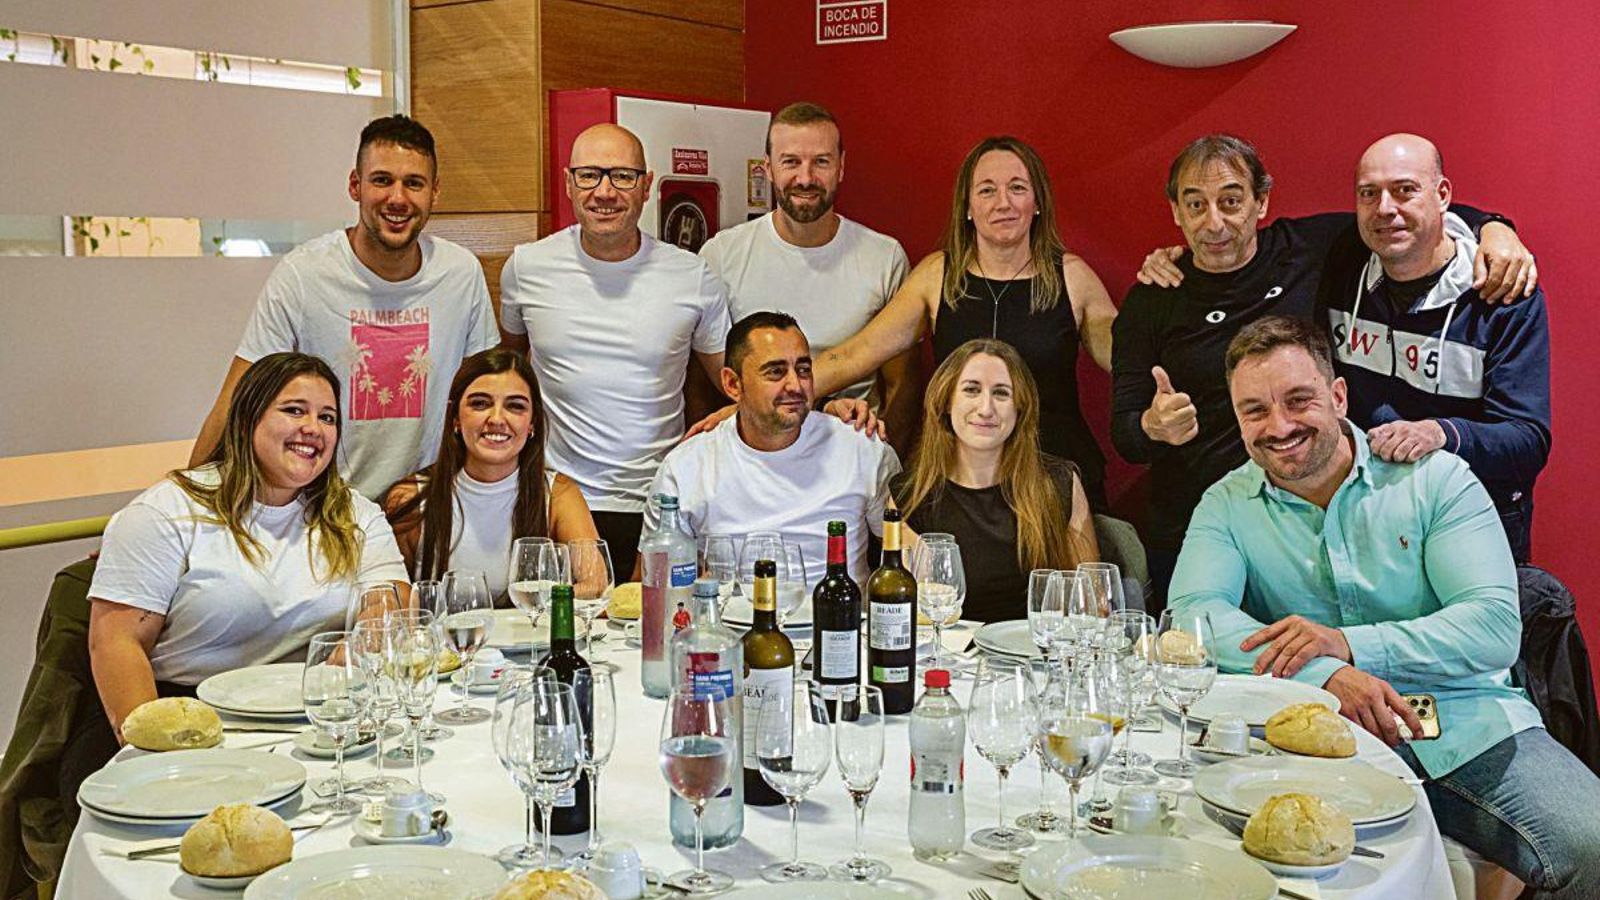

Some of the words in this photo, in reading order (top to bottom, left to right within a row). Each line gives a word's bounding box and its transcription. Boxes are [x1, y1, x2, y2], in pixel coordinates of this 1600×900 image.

[826, 9, 858, 22] BOCA
[861, 6, 877, 19] DE
[824, 21, 879, 37] INCENDIO
[350, 307, 429, 324] PALMBEACH
